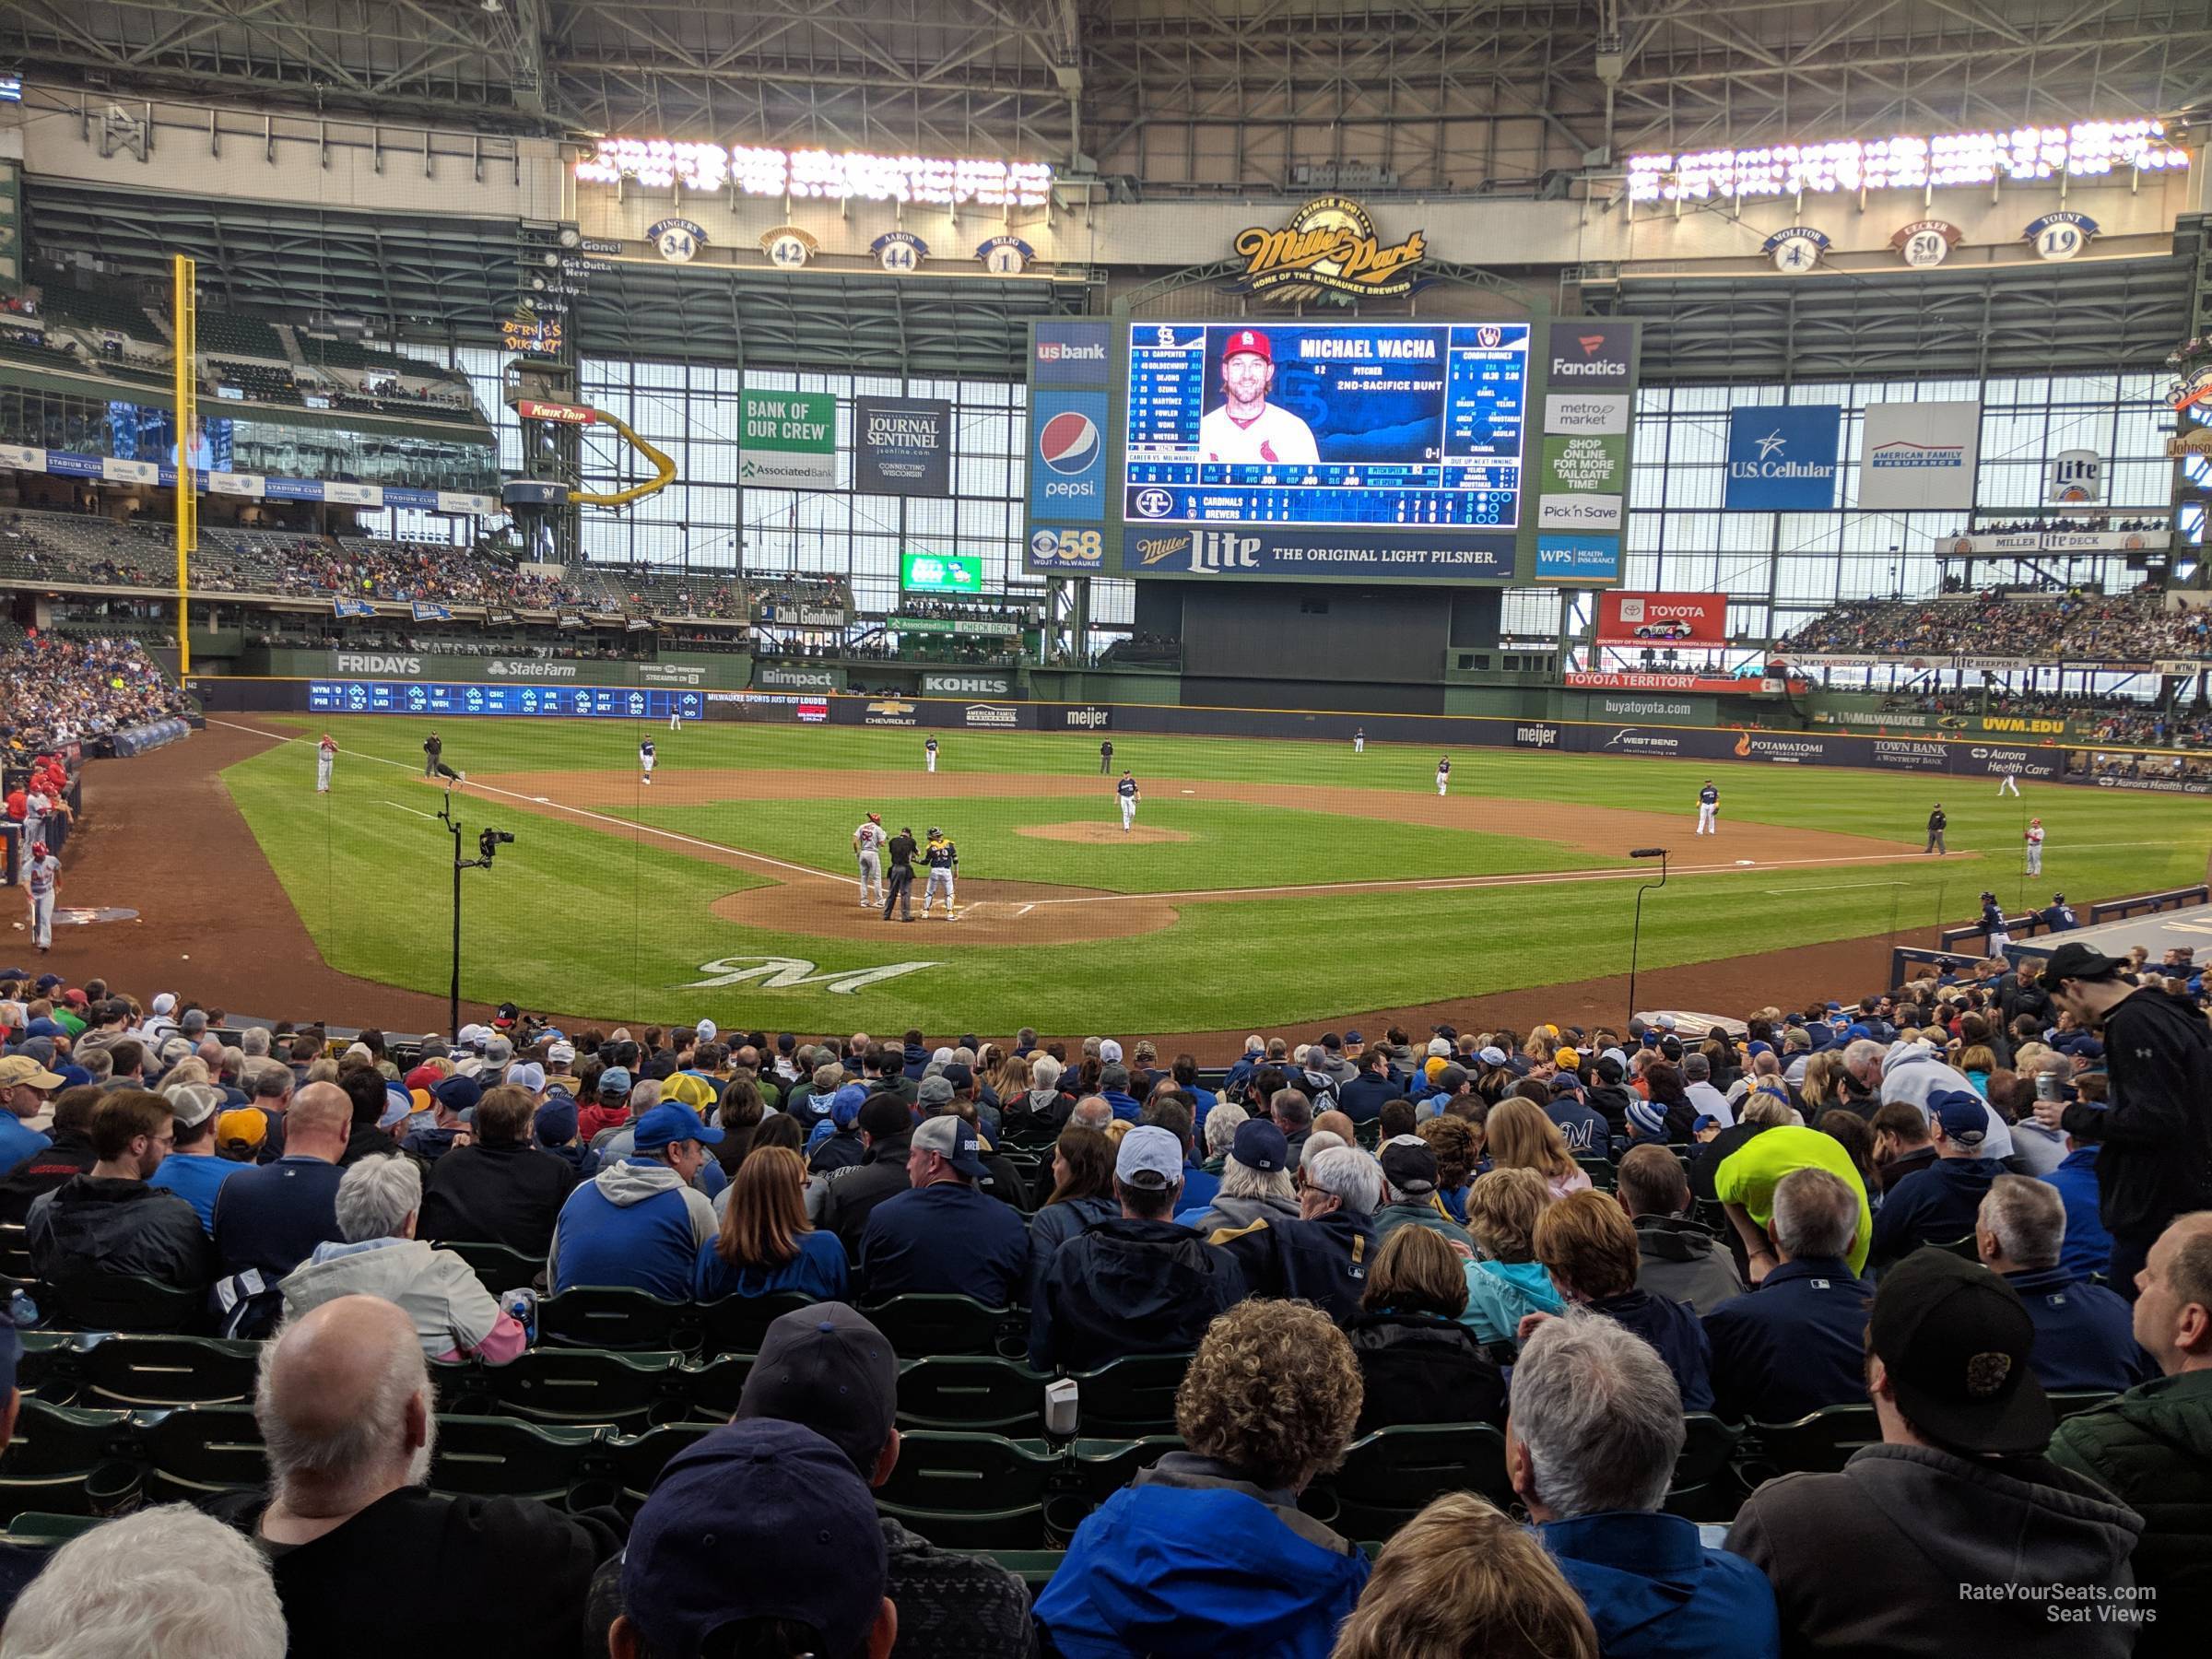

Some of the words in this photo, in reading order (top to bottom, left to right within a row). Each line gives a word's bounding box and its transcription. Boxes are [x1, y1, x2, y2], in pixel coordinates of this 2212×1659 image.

[1301, 199, 1335, 216] SINCE
[2041, 214, 2083, 224] YOUNT
[658, 219, 698, 234] FINGERS
[885, 233, 915, 244] AARON
[992, 237, 1019, 246] SELIG
[1773, 228, 1821, 242] MOLITOR
[2043, 230, 2078, 253] 19
[582, 241, 621, 253] Gone!
[664, 235, 690, 256] 34
[1912, 235, 1938, 253] 50
[775, 242, 802, 262] 42
[886, 248, 912, 268] 44
[1235, 228, 1353, 276] Miller
[1328, 230, 1427, 281] Park
[1787, 245, 1801, 265] 4
[562, 260, 580, 268] Get
[583, 260, 611, 271] Outta
[1001, 254, 1010, 271] 1
[566, 269, 590, 277] Here
[1253, 276, 1277, 289] HOME
[1279, 272, 1292, 281] OF
[1294, 272, 1311, 280] THE
[1314, 274, 1365, 295] MILWAUKEE
[1367, 282, 1411, 296] BREWERS
[567, 287, 580, 296] Up
[556, 303, 568, 313] Up
[1300, 339, 1373, 359] MICHAEL
[1377, 340, 1436, 359] WACHA
[1353, 367, 1382, 376] PITCHER
[1553, 359, 1626, 375] Fanatics
[1337, 381, 1411, 391] 2ND-SACIFICE
[1413, 382, 1442, 390] BUNT
[532, 405, 560, 418] KWIK
[562, 408, 585, 421] TRIP
[747, 400, 786, 418] BANK
[791, 403, 809, 419] OF
[1561, 404, 1601, 414] metro
[869, 418, 939, 435] JOURNAL
[1560, 415, 1606, 426] market
[747, 421, 778, 438] OUR
[867, 432, 938, 448] SENTINEL
[1569, 440, 1601, 449] SHOP
[1563, 449, 1606, 459] ONLINE
[1873, 452, 1924, 460] AMERICAN
[49, 458, 82, 468] STADIUM
[1554, 460, 1576, 469] FOR
[1581, 460, 1614, 470] MORE
[882, 469, 923, 477] WISCONSIN
[1557, 470, 1610, 479] TAILGATE
[1731, 462, 1759, 478] U.S.
[1761, 462, 1833, 478] Cellular
[2056, 461, 2097, 485] Lite
[266, 485, 301, 493] STADIUM
[1045, 481, 1095, 499] pepsi
[1567, 479, 1598, 489] TIME!
[384, 494, 417, 502] STADIUM
[1203, 497, 1242, 507] CARDINALS
[1206, 511, 1240, 519] BREWERS
[1544, 507, 1571, 517] Pick
[1584, 507, 1617, 518] Save
[1058, 530, 1102, 560] 58
[1996, 538, 2035, 547] MILLER
[2038, 534, 2066, 551] Lite
[2069, 536, 2100, 545] DECK
[1136, 536, 1190, 564] Miller
[1187, 530, 1261, 574] Lite
[1273, 548, 1304, 560] THE
[1307, 548, 1378, 561] ORIGINAL
[1382, 550, 1428, 563] LIGHT
[1431, 551, 1498, 564] PILSNER.
[1540, 550, 1571, 562] WPS
[776, 606, 798, 623] Club
[801, 608, 843, 626] Goodwill
[1650, 606, 1705, 618] TOYOTA
[961, 623, 989, 631] CHECK
[991, 624, 1012, 632] DECK
[338, 655, 421, 674] FRIDAYS
[1975, 660, 2011, 668] BEERPEN
[646, 674, 677, 682] STREAMING
[776, 668, 831, 687] impact
[1569, 674, 1618, 685] TOYOTA
[1622, 675, 1696, 688] TERRITORY
[926, 678, 1008, 693] KOHL'S
[708, 693, 745, 701] MILWAUKEE
[1606, 700, 1691, 715] buyatoyota.com
[1067, 707, 1108, 729] meijer
[1983, 717, 2065, 734] UWM.EDU
[1517, 724, 1557, 747] meijer
[1651, 738, 1678, 747] BEND
[1751, 741, 1823, 753] POTAWATOMI
[1874, 740, 1911, 751] TOWN
[1913, 743, 1948, 757] BANK
[1882, 755, 1921, 764] WINTRUST
[1990, 748, 2027, 761] Aurora
[2025, 764, 2050, 775] Care
[2116, 779, 2147, 789] Aurora
[2149, 781, 2183, 791] Health
[2184, 782, 2206, 794] Care
[862, 830, 873, 841] 52
